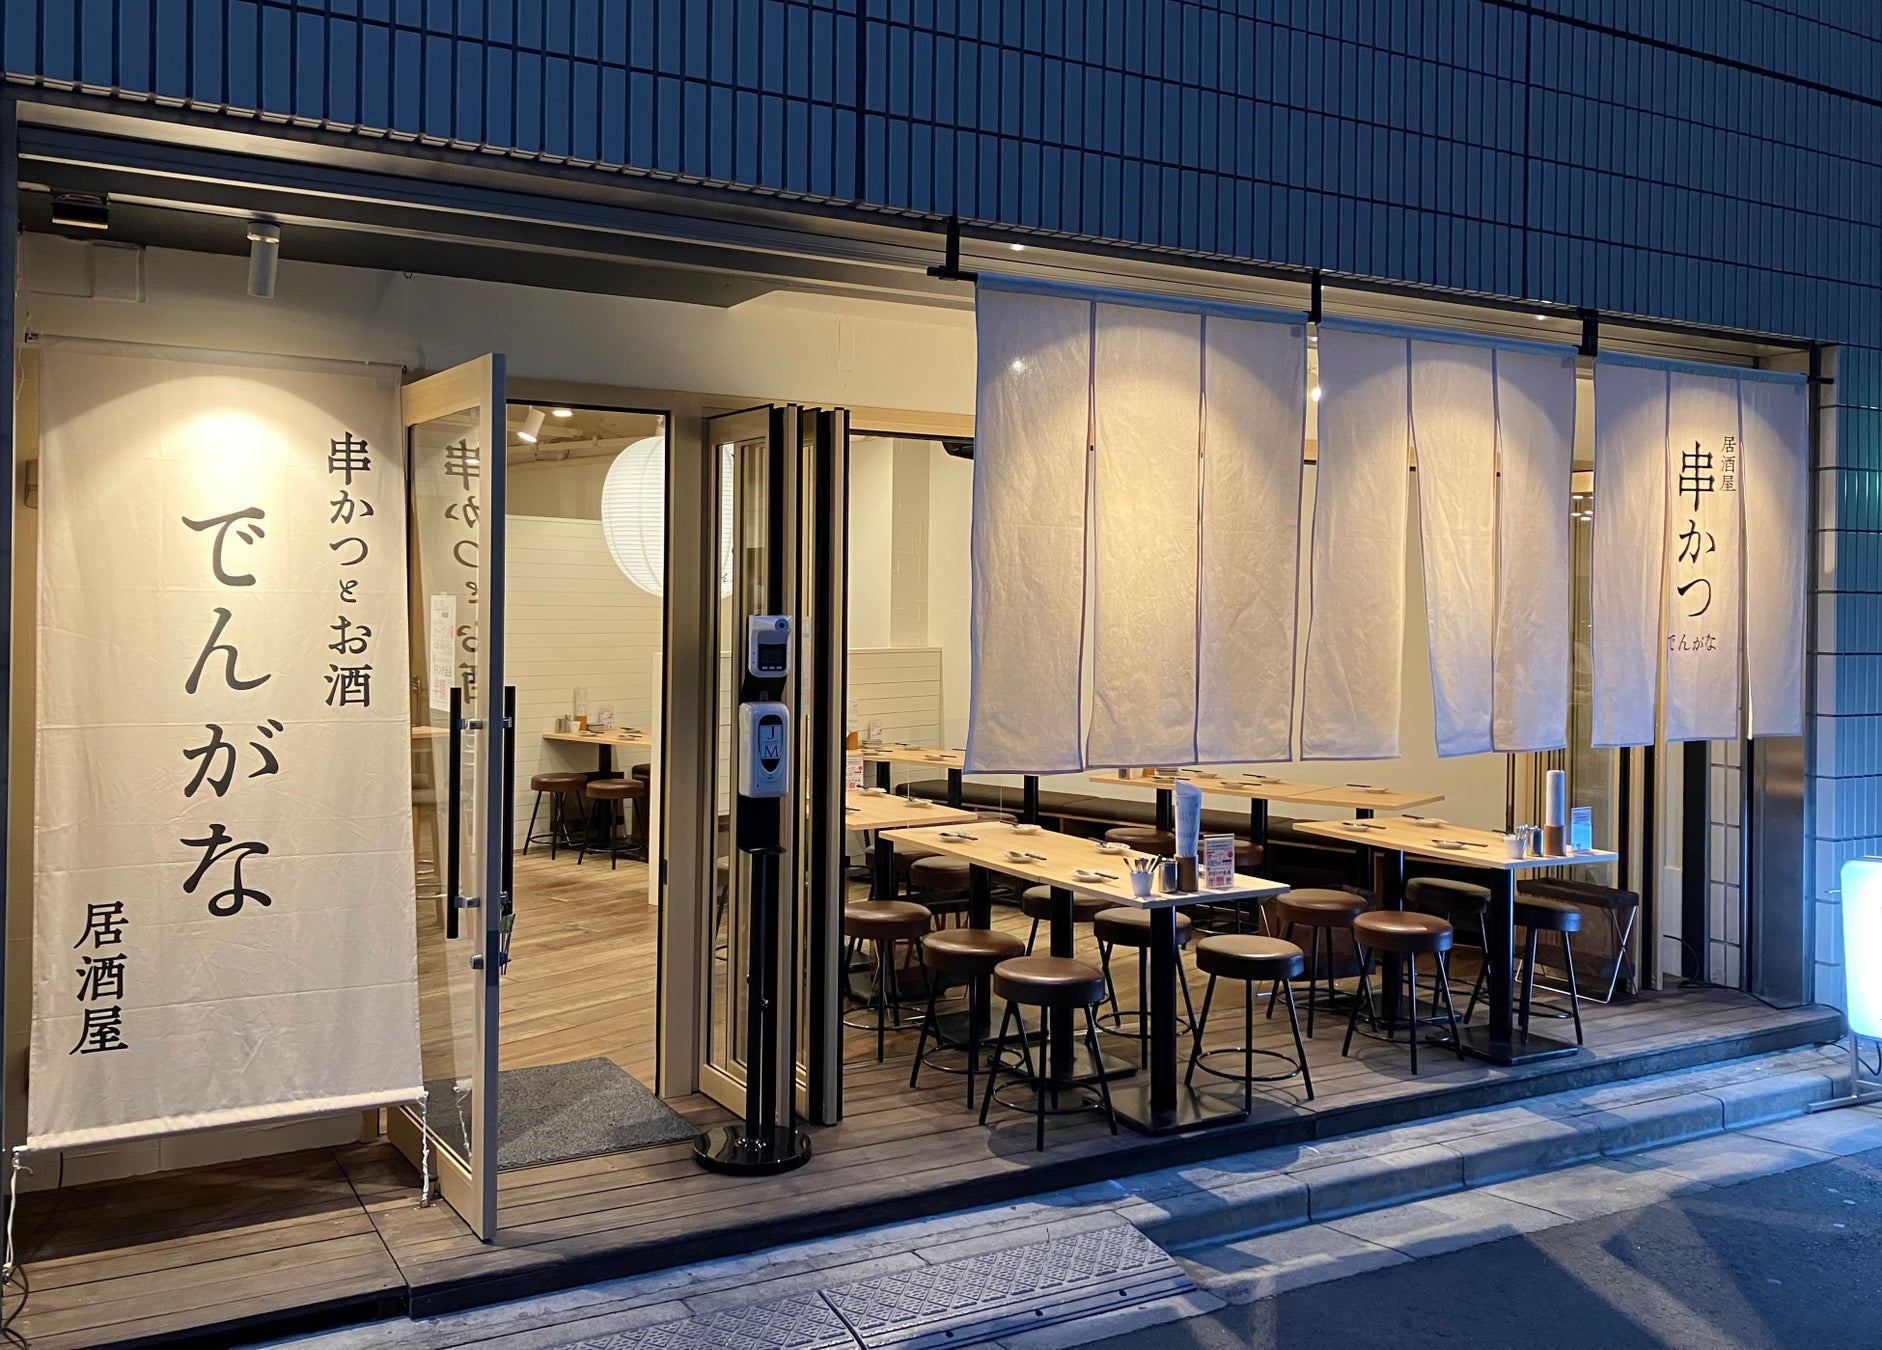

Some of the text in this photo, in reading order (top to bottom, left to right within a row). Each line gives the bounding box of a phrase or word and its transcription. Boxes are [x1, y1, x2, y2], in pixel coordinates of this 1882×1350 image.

[1676, 439, 1716, 617] 串かつ
[1719, 435, 1737, 493] 居酒屋
[324, 431, 374, 708] 串かつとお酒
[180, 506, 284, 918] でんがな
[68, 900, 130, 1056] 居酒屋
